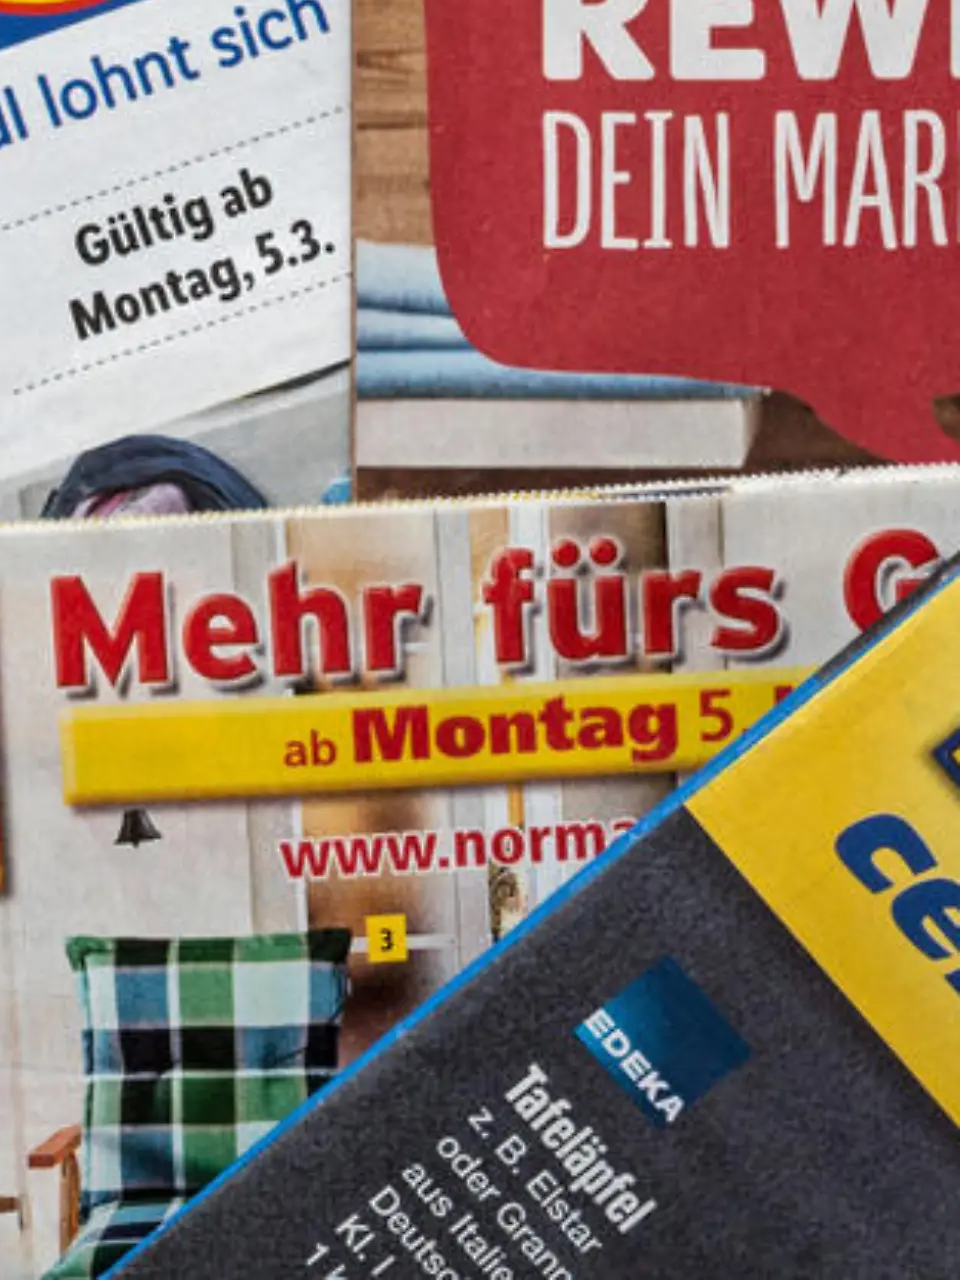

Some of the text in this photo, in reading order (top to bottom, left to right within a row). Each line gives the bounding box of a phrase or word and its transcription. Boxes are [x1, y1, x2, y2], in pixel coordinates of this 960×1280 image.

[38, 36, 200, 128] lohnt
[75, 168, 273, 266] Gültig ab
[543, 109, 960, 249] DEIN MAR
[70, 219, 335, 340] Montag, 5.3.
[49, 560, 425, 692] Mehr
[482, 537, 784, 666] fürs
[283, 730, 337, 767] ab
[352, 694, 679, 763] Montag
[380, 929, 394, 951] 3
[583, 1007, 685, 1122] EDEKA
[402, 1163, 454, 1218] aus
[436, 1136, 501, 1201] oder
[468, 1107, 602, 1254] z. B. Elstar
[504, 1062, 658, 1234] Tafeläpfel
